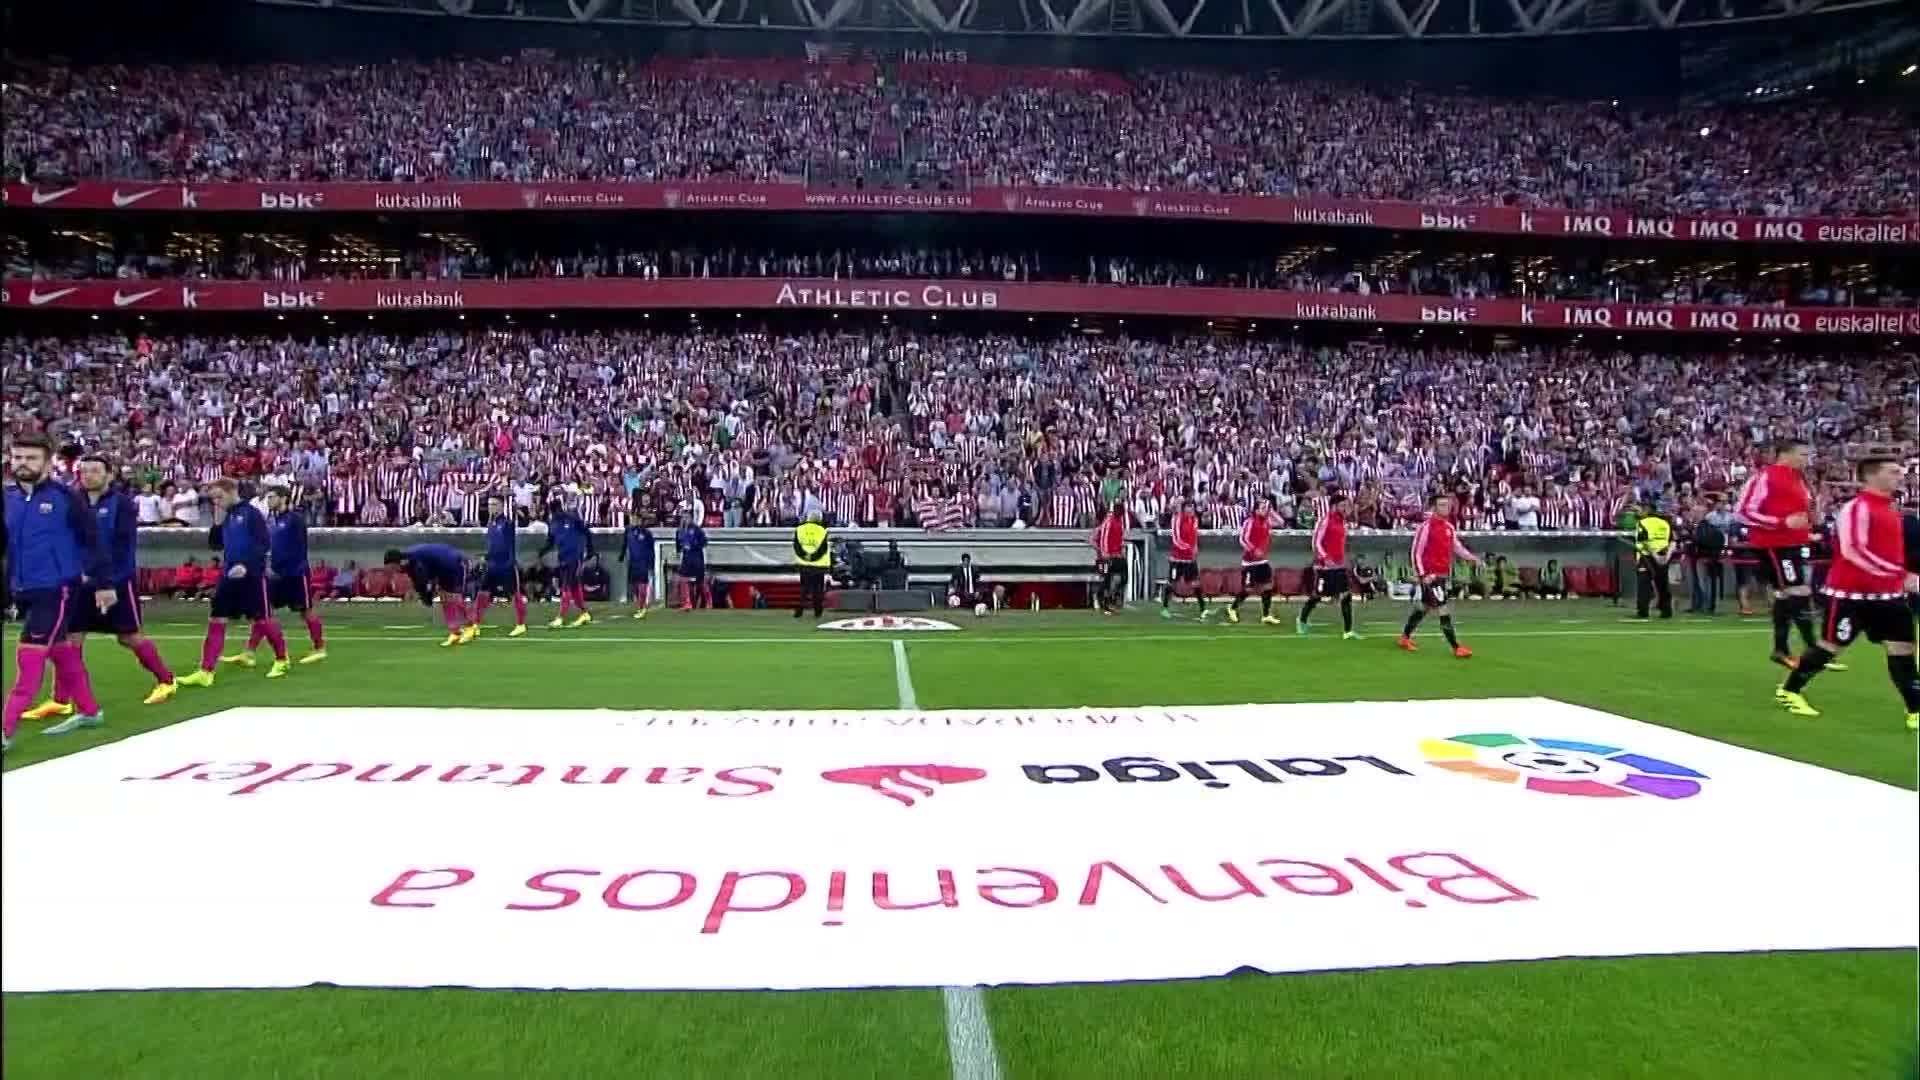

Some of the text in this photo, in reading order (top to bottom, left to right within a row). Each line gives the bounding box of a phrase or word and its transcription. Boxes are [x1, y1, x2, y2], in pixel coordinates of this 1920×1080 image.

[182, 186, 197, 207] k
[261, 192, 316, 208] bbk
[375, 192, 463, 208] kutxabank
[1293, 208, 1374, 224] kutxabank
[1420, 212, 1467, 228] bbk
[1521, 211, 1533, 231] k
[1563, 215, 1612, 236] IMQ
[1627, 218, 1675, 238] IMQ
[1690, 219, 1739, 240] IMQ
[1754, 220, 1805, 241] IMQ
[1818, 223, 1907, 242] euskaltel
[183, 287, 198, 308] k
[263, 291, 317, 308] bbk
[376, 290, 464, 307] kutxabank
[1296, 303, 1377, 321] kutxabank
[1421, 306, 1468, 323] bbk
[1521, 303, 1533, 324] k
[1563, 307, 1612, 329] IMQ
[1625, 309, 1673, 329] IMQ
[1690, 310, 1738, 331] IMQ
[1752, 310, 1802, 331] IMQ
[1815, 317, 1904, 334] euskaltel
[118, 756, 1416, 797] LaLiga Santander
[369, 852, 1539, 935] Bienvenidos a
